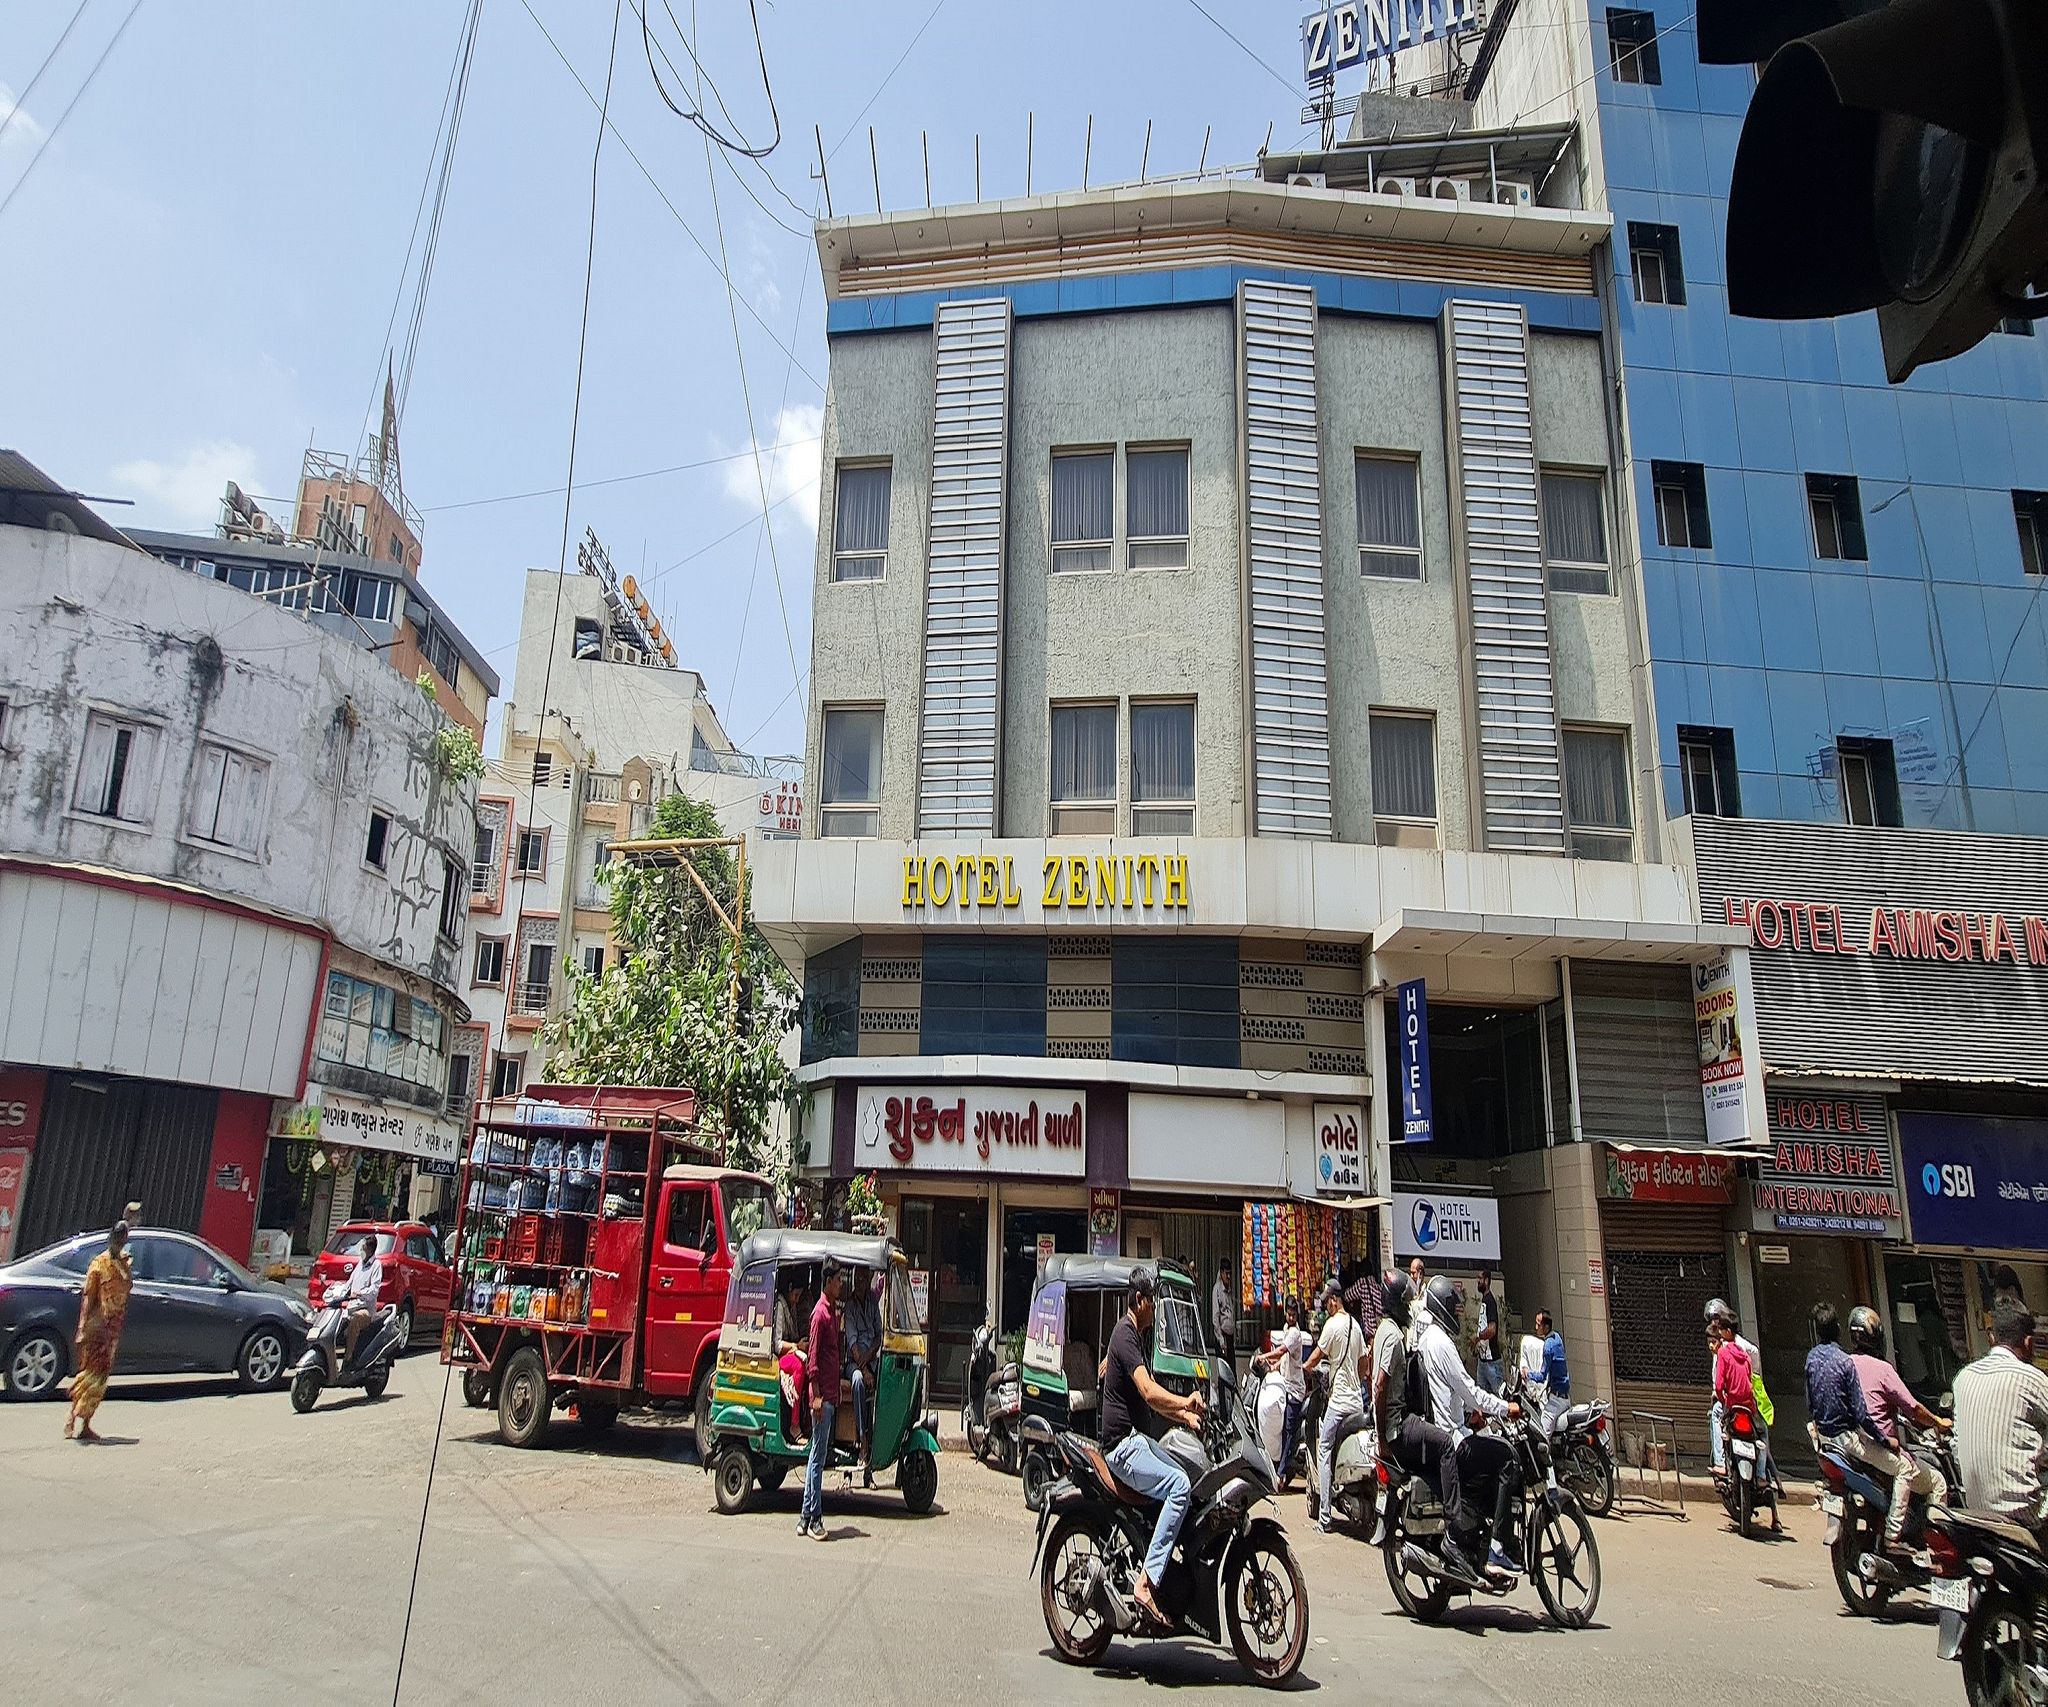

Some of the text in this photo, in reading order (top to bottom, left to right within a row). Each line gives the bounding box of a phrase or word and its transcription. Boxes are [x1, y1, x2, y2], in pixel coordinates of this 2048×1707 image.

[901, 853, 1188, 907] HOTEL ZENITH
[1723, 896, 1858, 953] HOTEL
[1871, 906, 2020, 963] AMISHA
[1698, 963, 1731, 988] ZENITH
[1708, 957, 1725, 967] HOTEL
[1696, 990, 1734, 1018] ROOMS
[1406, 988, 1421, 1115] HOTEL
[1702, 1060, 1742, 1081] BOOK NOW
[321, 1099, 349, 1128] ગણેશ
[1405, 1120, 1430, 1134] ZENITH
[1777, 1099, 1870, 1132] HOTEL
[884, 1096, 1082, 1162] શુકન ગુજરાતી થાળી
[1321, 1113, 1358, 1151] ભોલે
[427, 1162, 450, 1173] PLAZA
[1340, 1154, 1358, 1167] પાન
[1775, 1142, 1884, 1176] AMISHA
[1333, 1168, 1359, 1185] હાઉસ
[1943, 1164, 1976, 1198] SBI
[1754, 1183, 1901, 1217] INTERNATIONAL
[2031, 1182, 2048, 1202] एटी
[1418, 1203, 1482, 1243] ZENITH
[1440, 1203, 1471, 1217] HOTEL
[1184, 1614, 1210, 1638] SUZUKI
